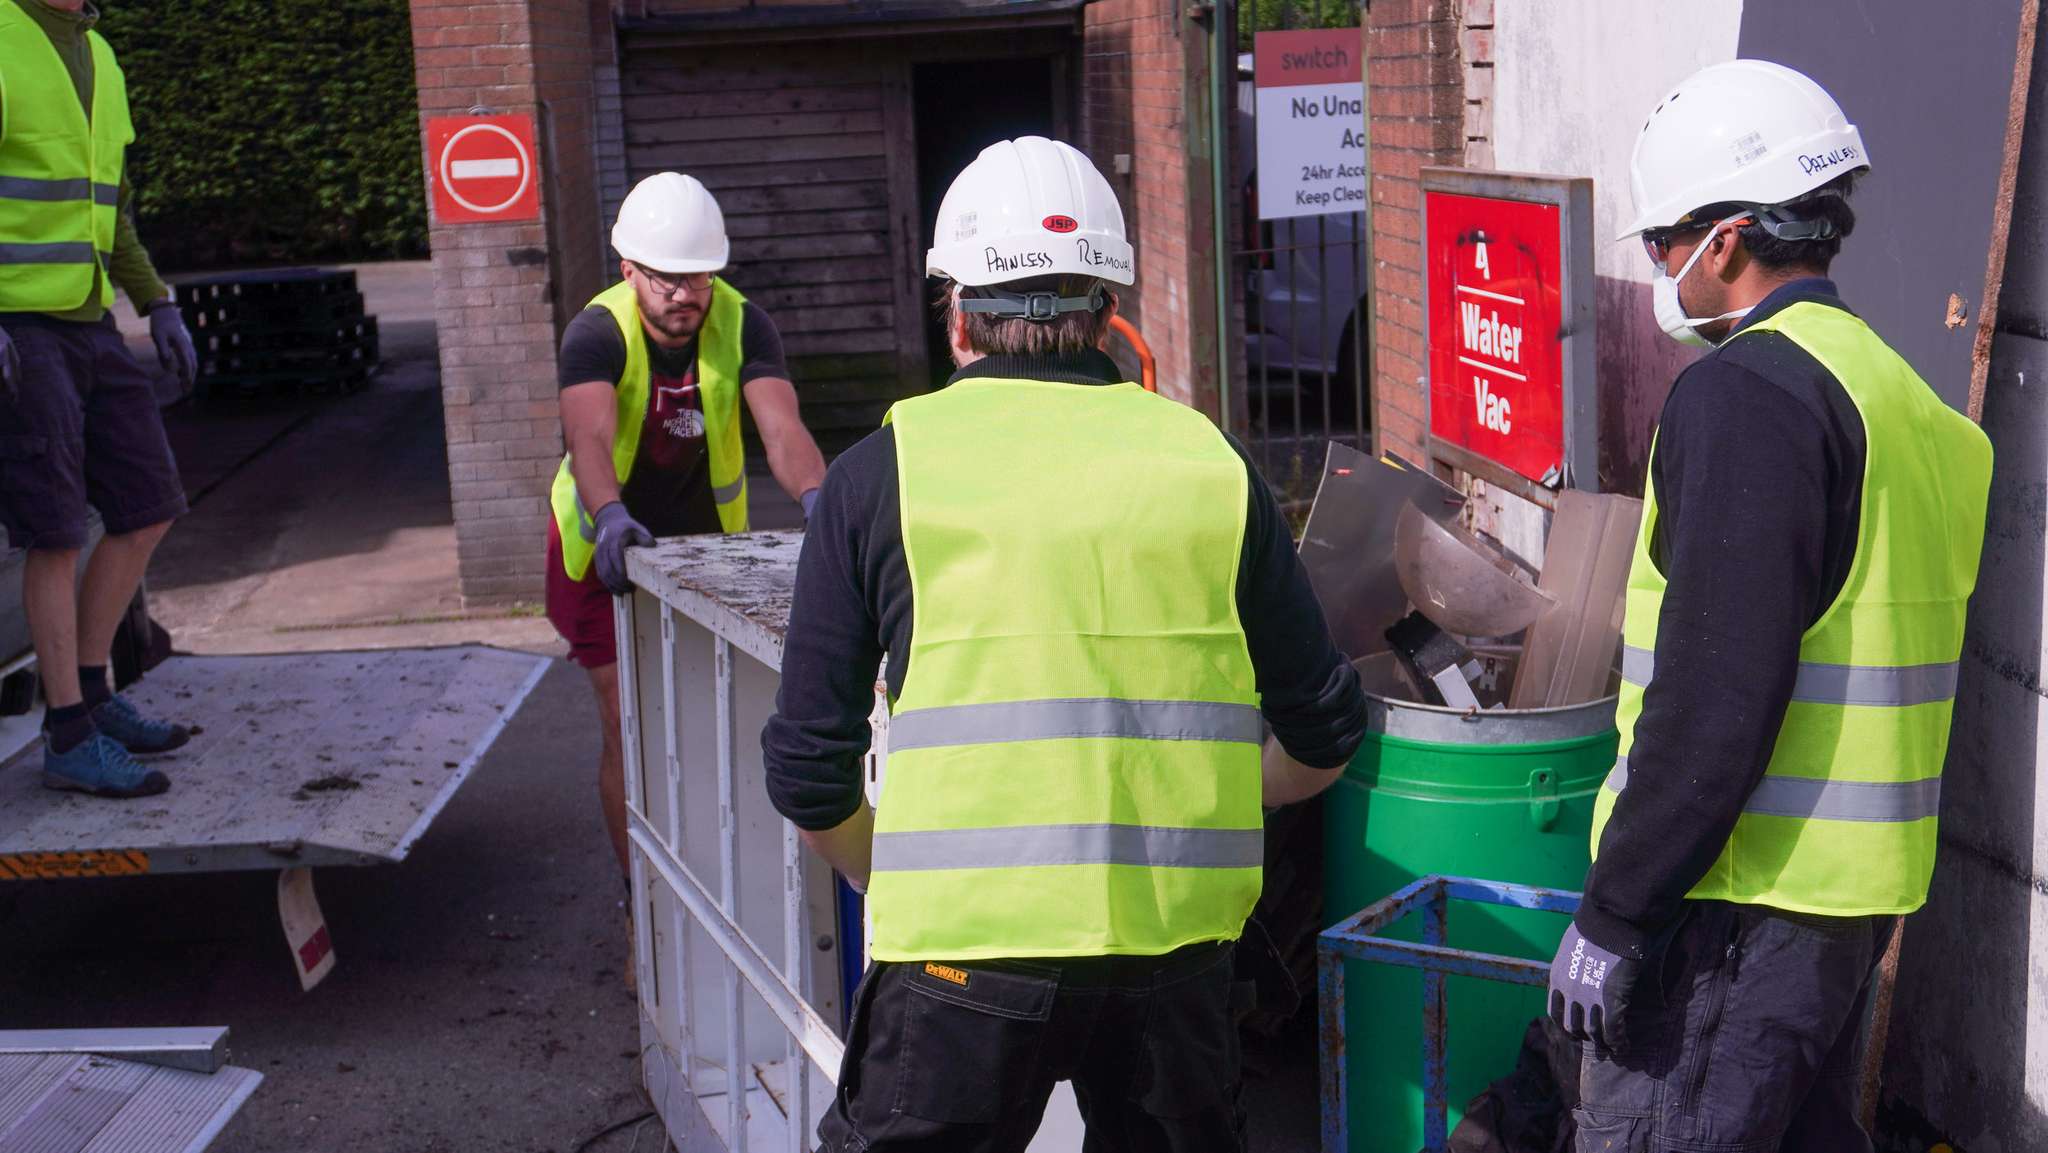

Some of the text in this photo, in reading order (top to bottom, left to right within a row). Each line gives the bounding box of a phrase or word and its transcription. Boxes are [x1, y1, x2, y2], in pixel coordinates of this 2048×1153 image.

[1282, 45, 1348, 71] switch
[1291, 96, 1320, 119] No
[1302, 164, 1334, 181] 24hr
[1798, 145, 1859, 176] PAINLESS
[1295, 189, 1331, 207] Keep
[1047, 217, 1073, 230] JSP
[985, 246, 1053, 273] PAINLESS
[1461, 301, 1522, 364] Water
[1474, 376, 1511, 435] Vac
[925, 963, 968, 986] DeWALT
